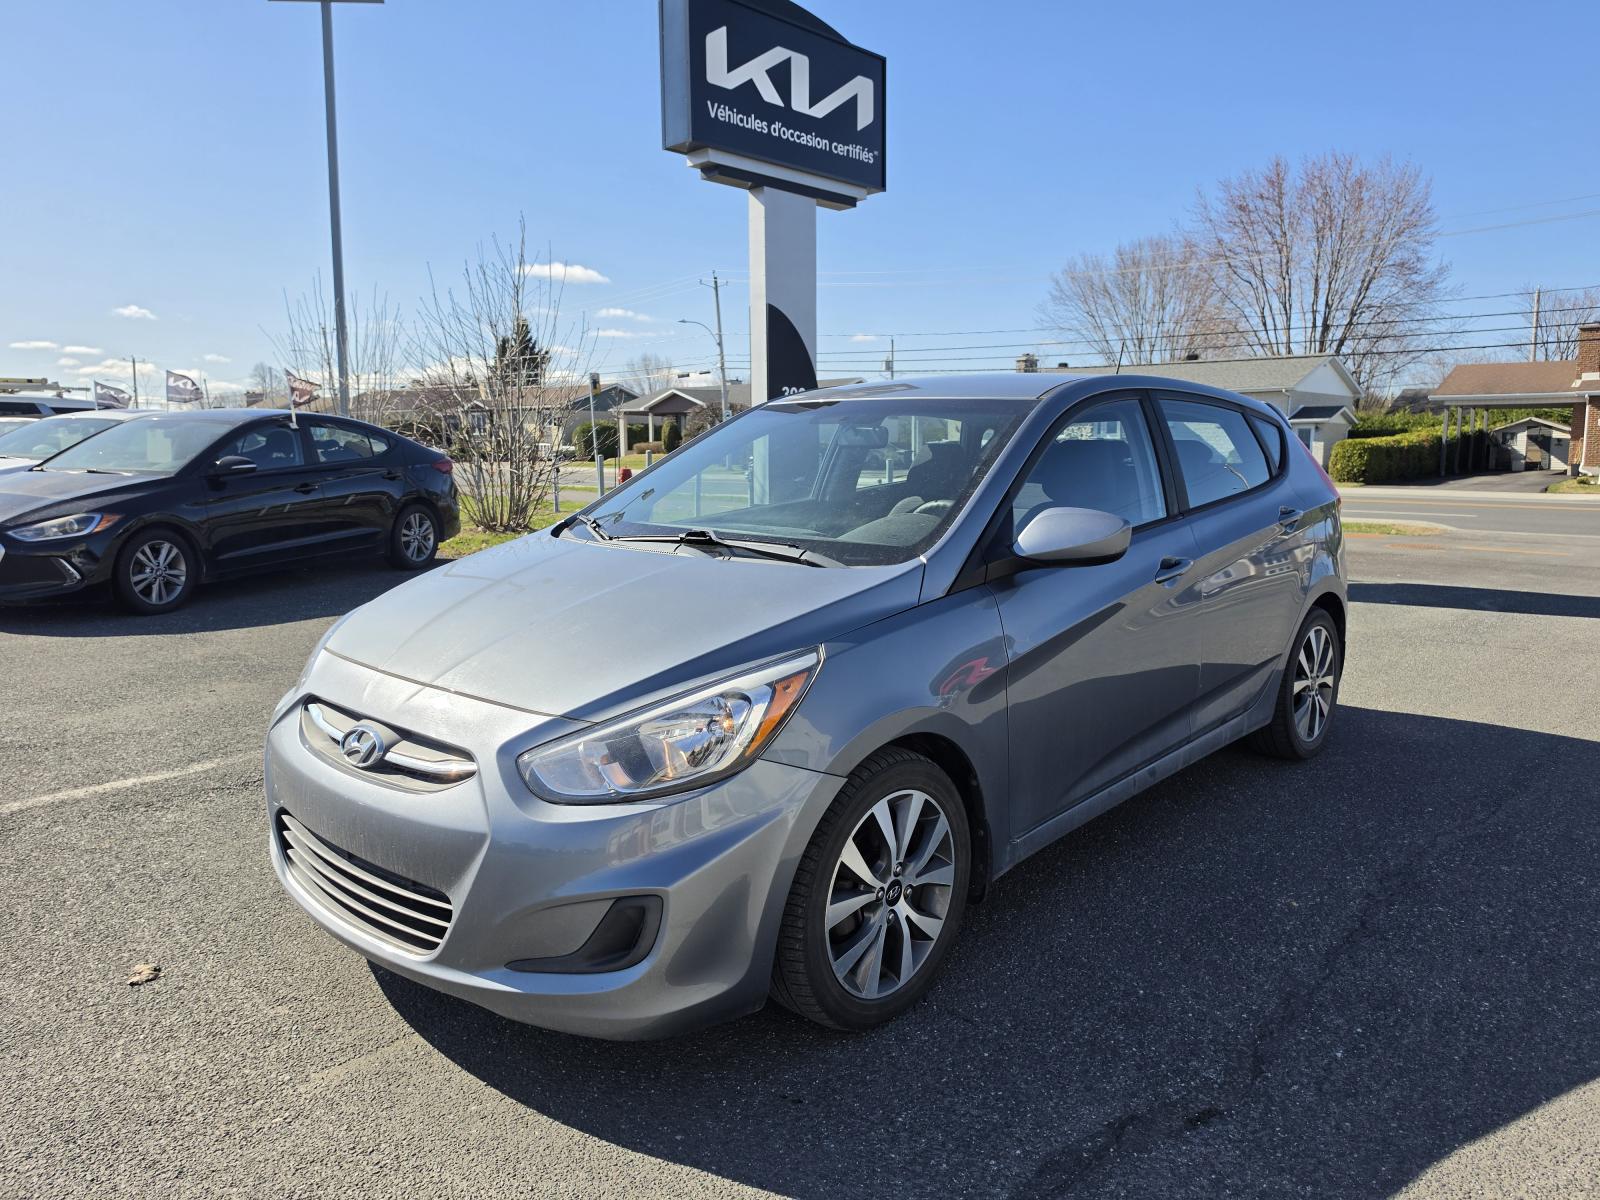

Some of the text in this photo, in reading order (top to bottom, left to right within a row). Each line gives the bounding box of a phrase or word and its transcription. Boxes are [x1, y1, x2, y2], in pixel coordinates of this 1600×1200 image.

[706, 25, 874, 132] KIA
[706, 100, 768, 134] Véhicules
[770, 120, 830, 152] d'occasion
